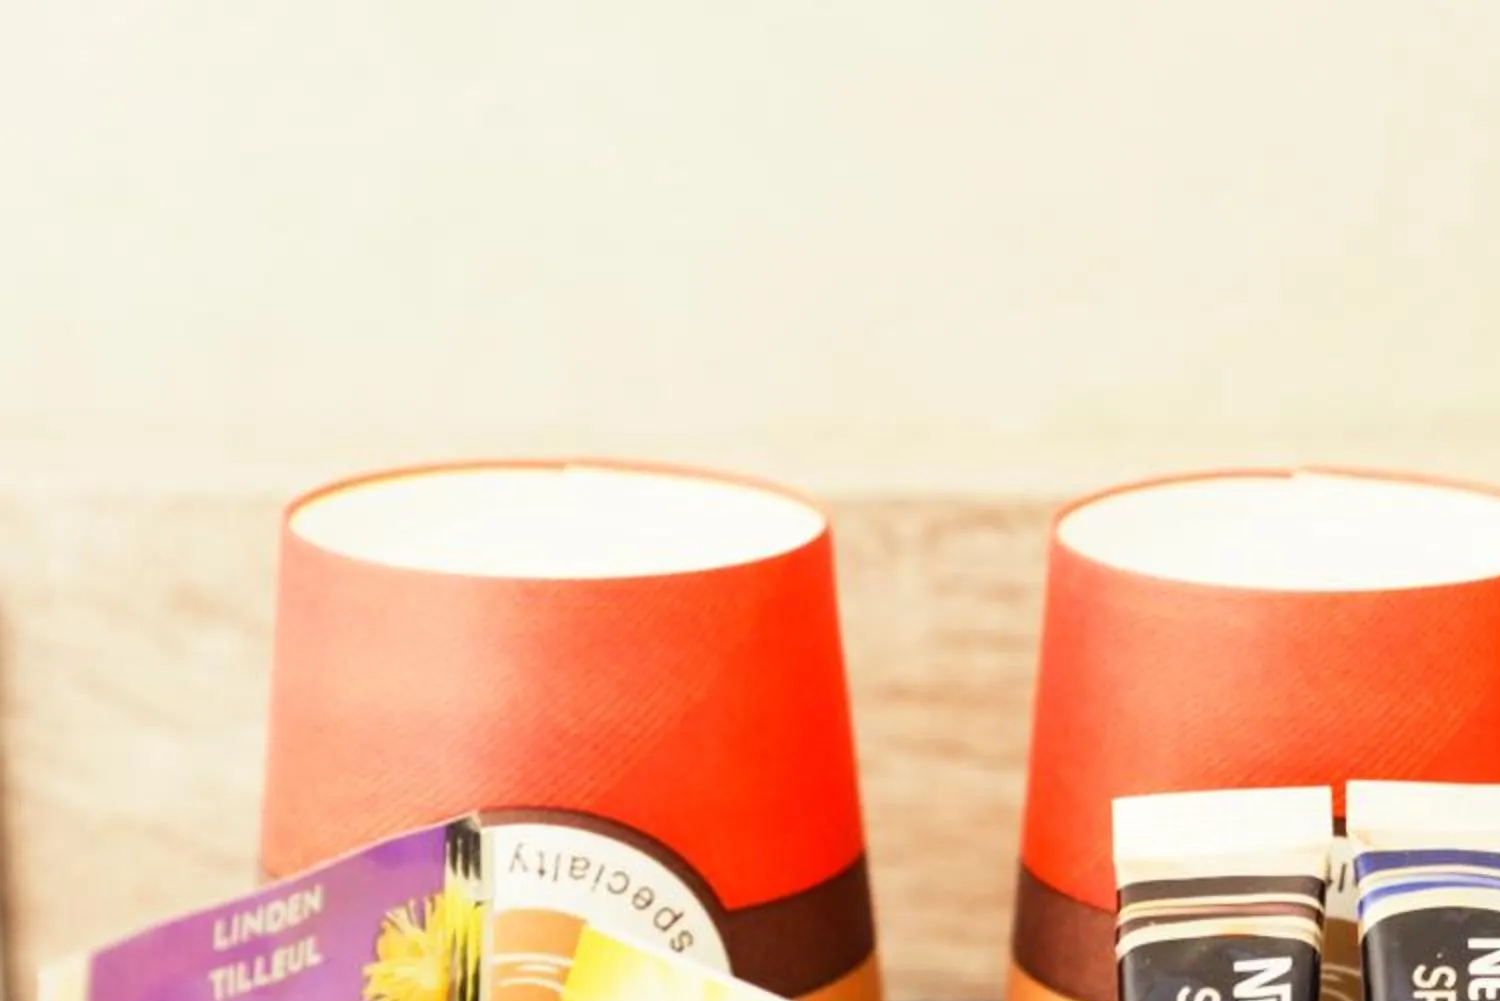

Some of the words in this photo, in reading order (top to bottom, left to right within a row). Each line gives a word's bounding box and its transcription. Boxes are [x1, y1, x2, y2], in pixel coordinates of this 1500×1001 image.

[212, 884, 323, 951] LINDEN
[507, 842, 695, 954] specialty
[208, 936, 322, 1001] TILLEUL
